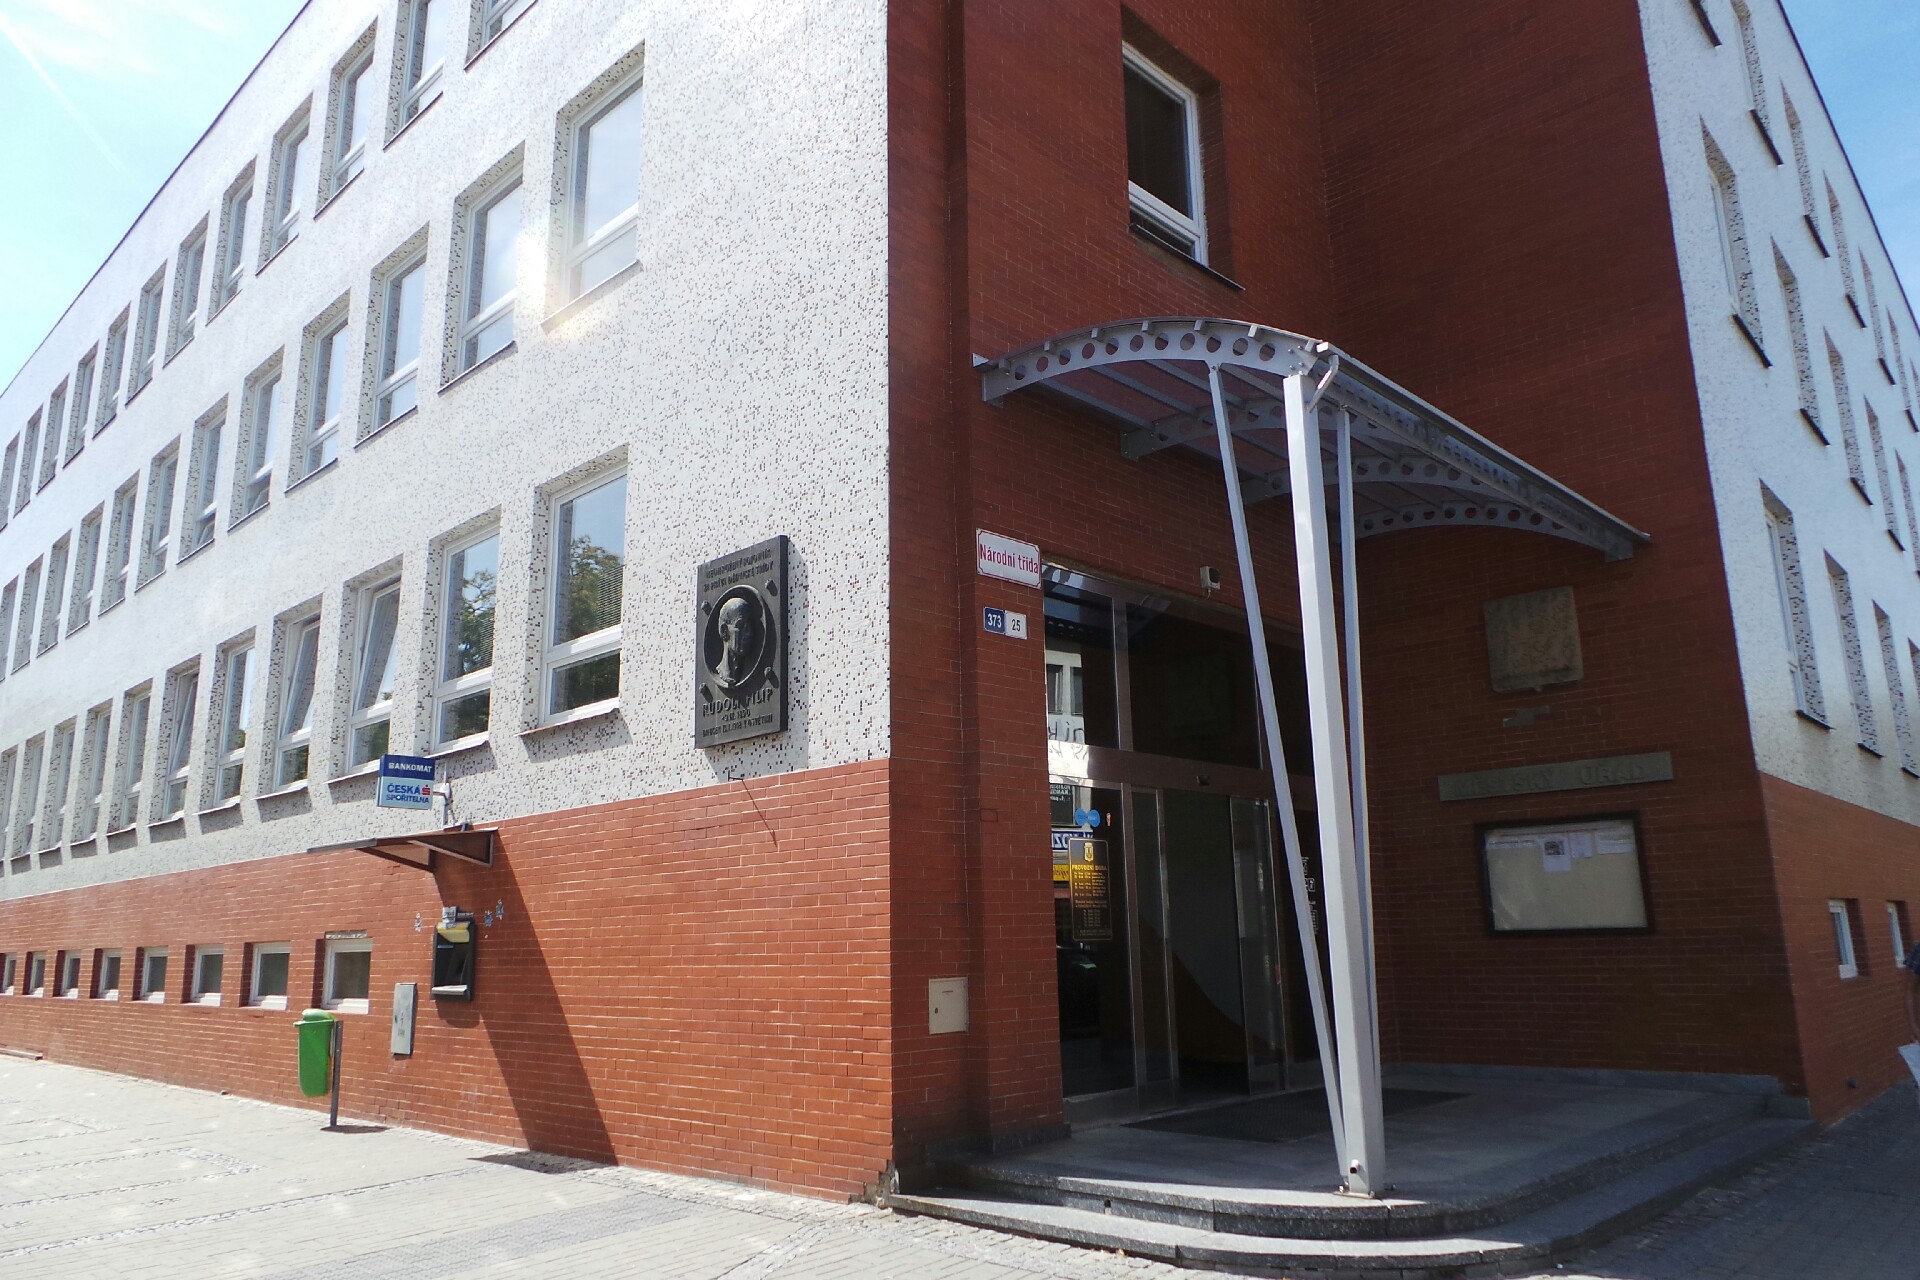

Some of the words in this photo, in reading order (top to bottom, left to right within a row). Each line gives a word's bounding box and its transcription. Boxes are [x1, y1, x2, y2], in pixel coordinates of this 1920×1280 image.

[979, 543, 1016, 568] Národní
[1018, 554, 1039, 575] třída
[987, 613, 1002, 628] 373
[1011, 618, 1021, 632] 25
[388, 762, 433, 773] BANKOMAT
[387, 783, 421, 795] ČESKÁ
[386, 794, 429, 804] SPOŘITELNA
